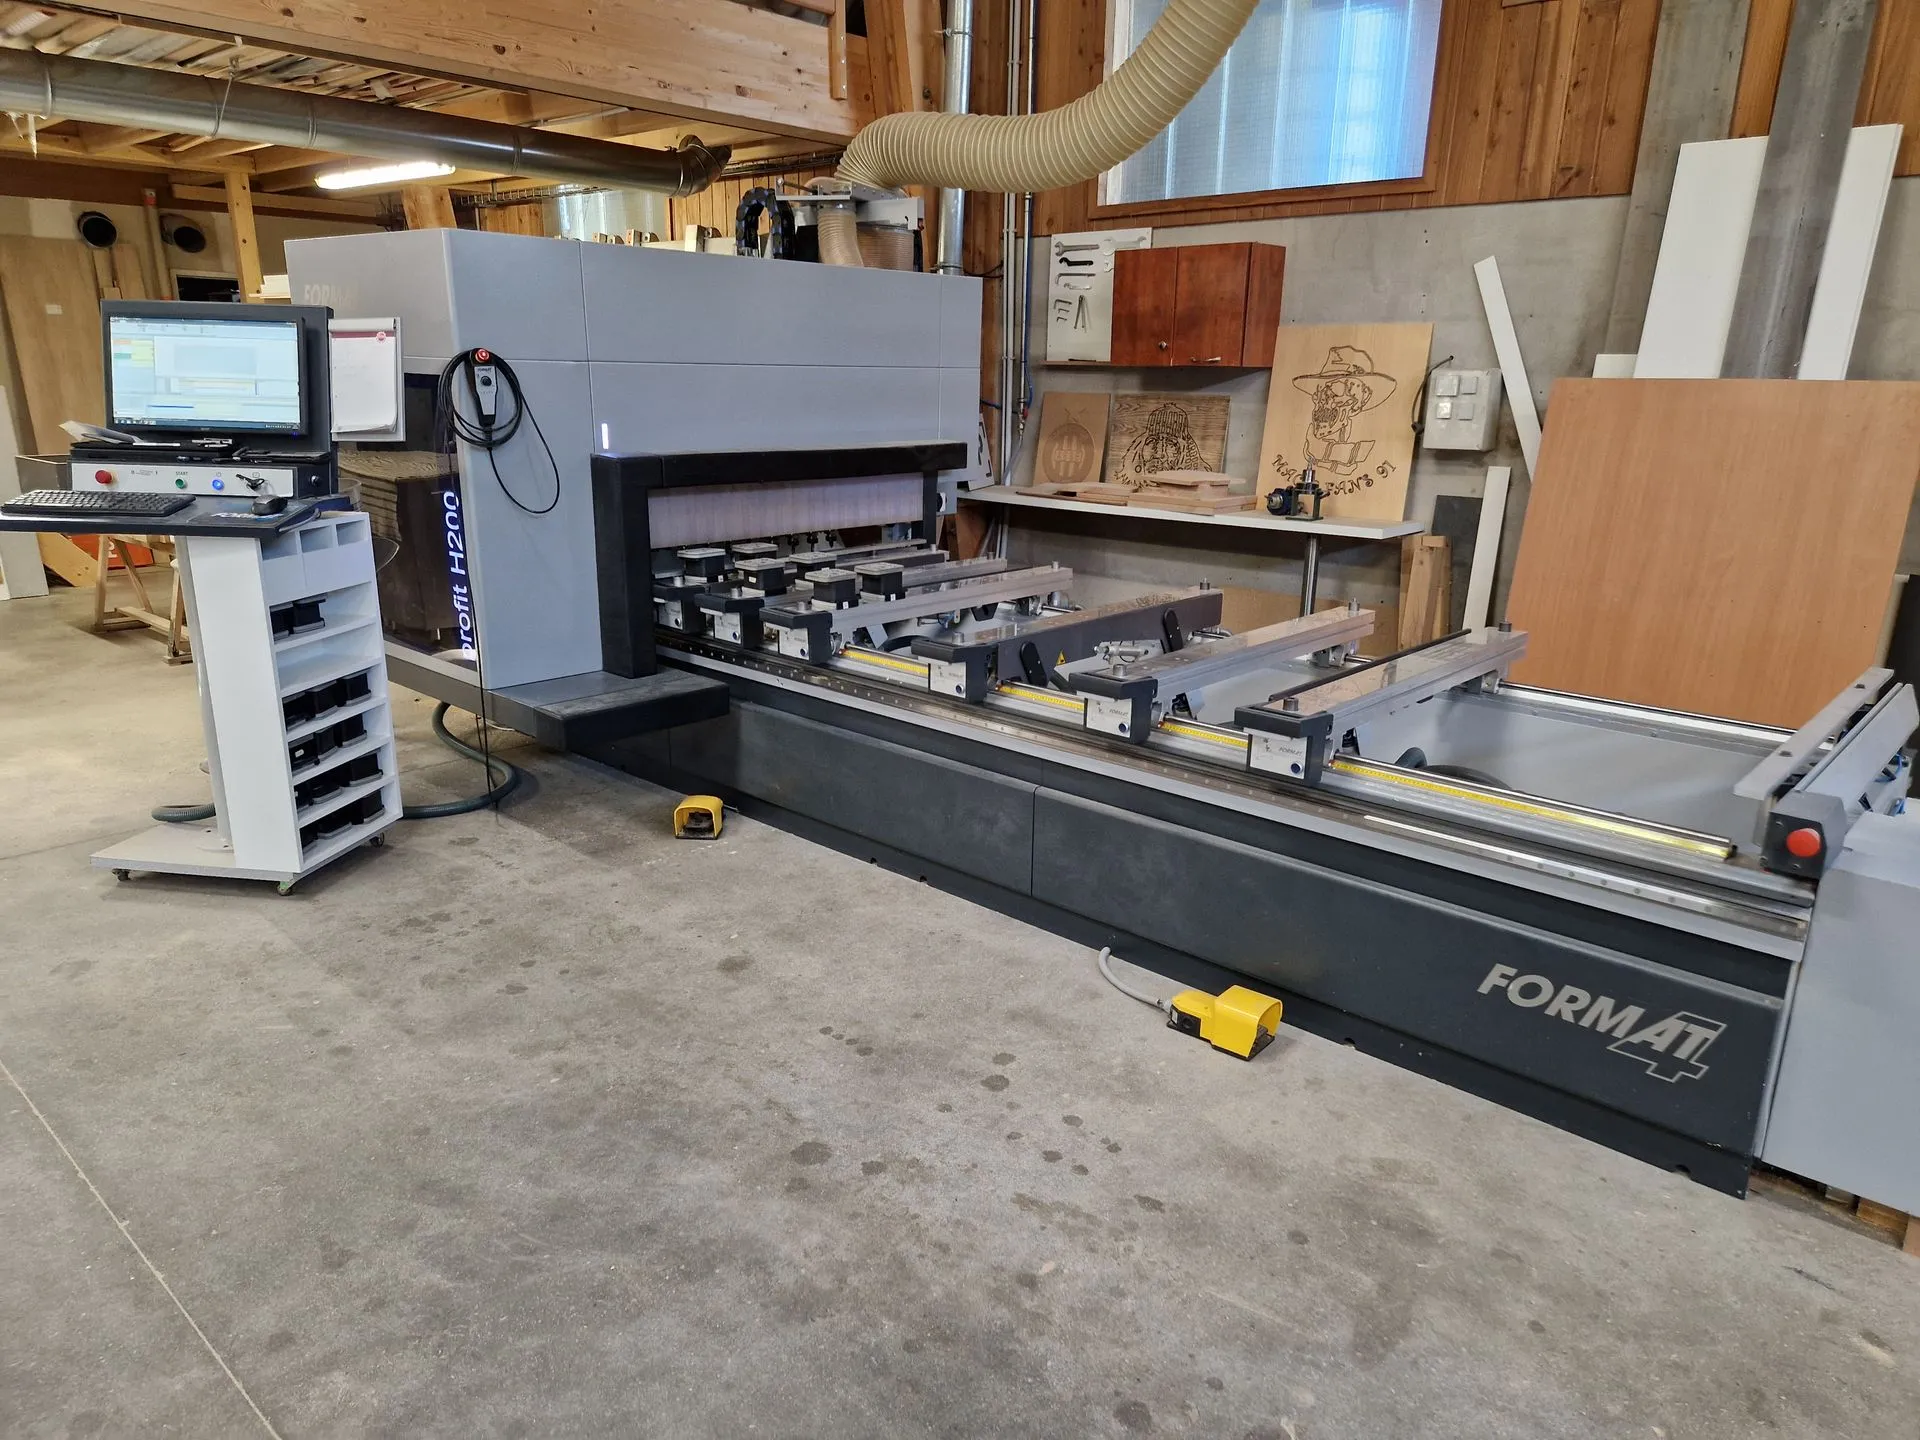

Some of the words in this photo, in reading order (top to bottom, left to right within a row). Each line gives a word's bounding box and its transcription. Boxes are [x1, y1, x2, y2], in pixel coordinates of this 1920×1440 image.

[1375, 460, 1397, 478] 91
[443, 491, 466, 575] H200
[453, 584, 477, 662] profit
